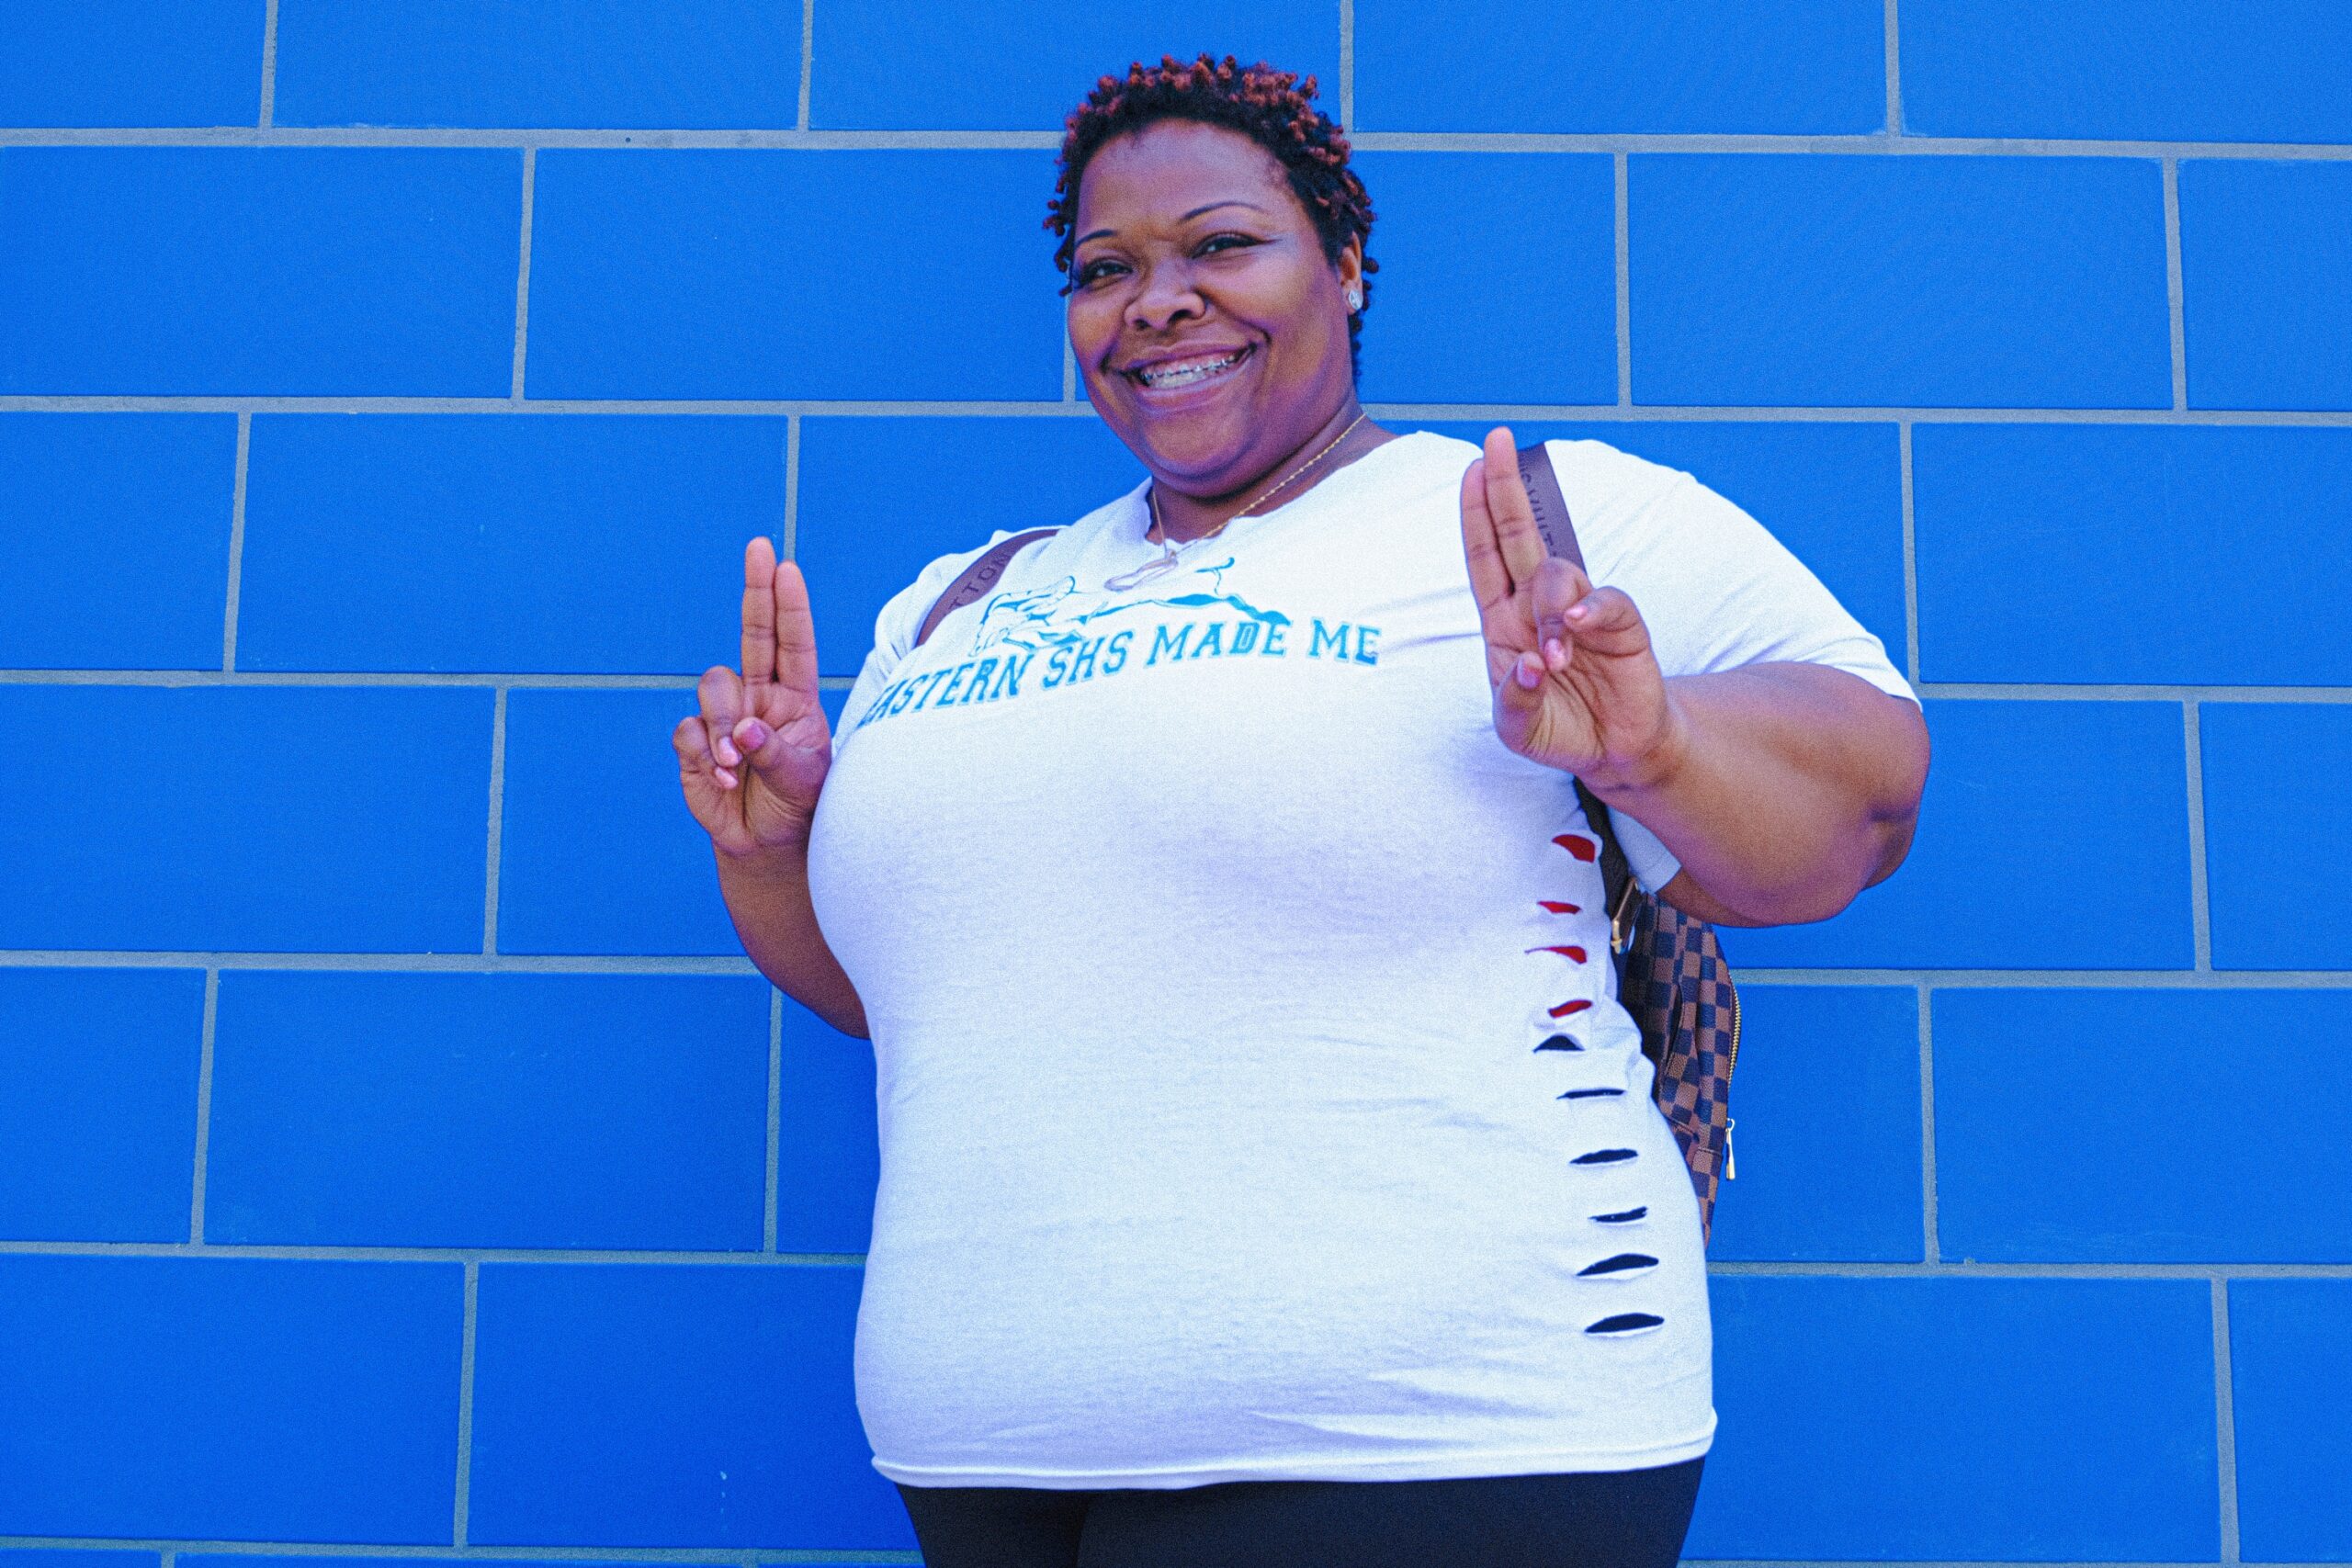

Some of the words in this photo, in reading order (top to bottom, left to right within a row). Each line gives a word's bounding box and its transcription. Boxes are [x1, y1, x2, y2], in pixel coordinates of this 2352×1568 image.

[1042, 630, 1134, 689] SHS
[1145, 620, 1288, 666] MADE
[1307, 617, 1381, 666] ME
